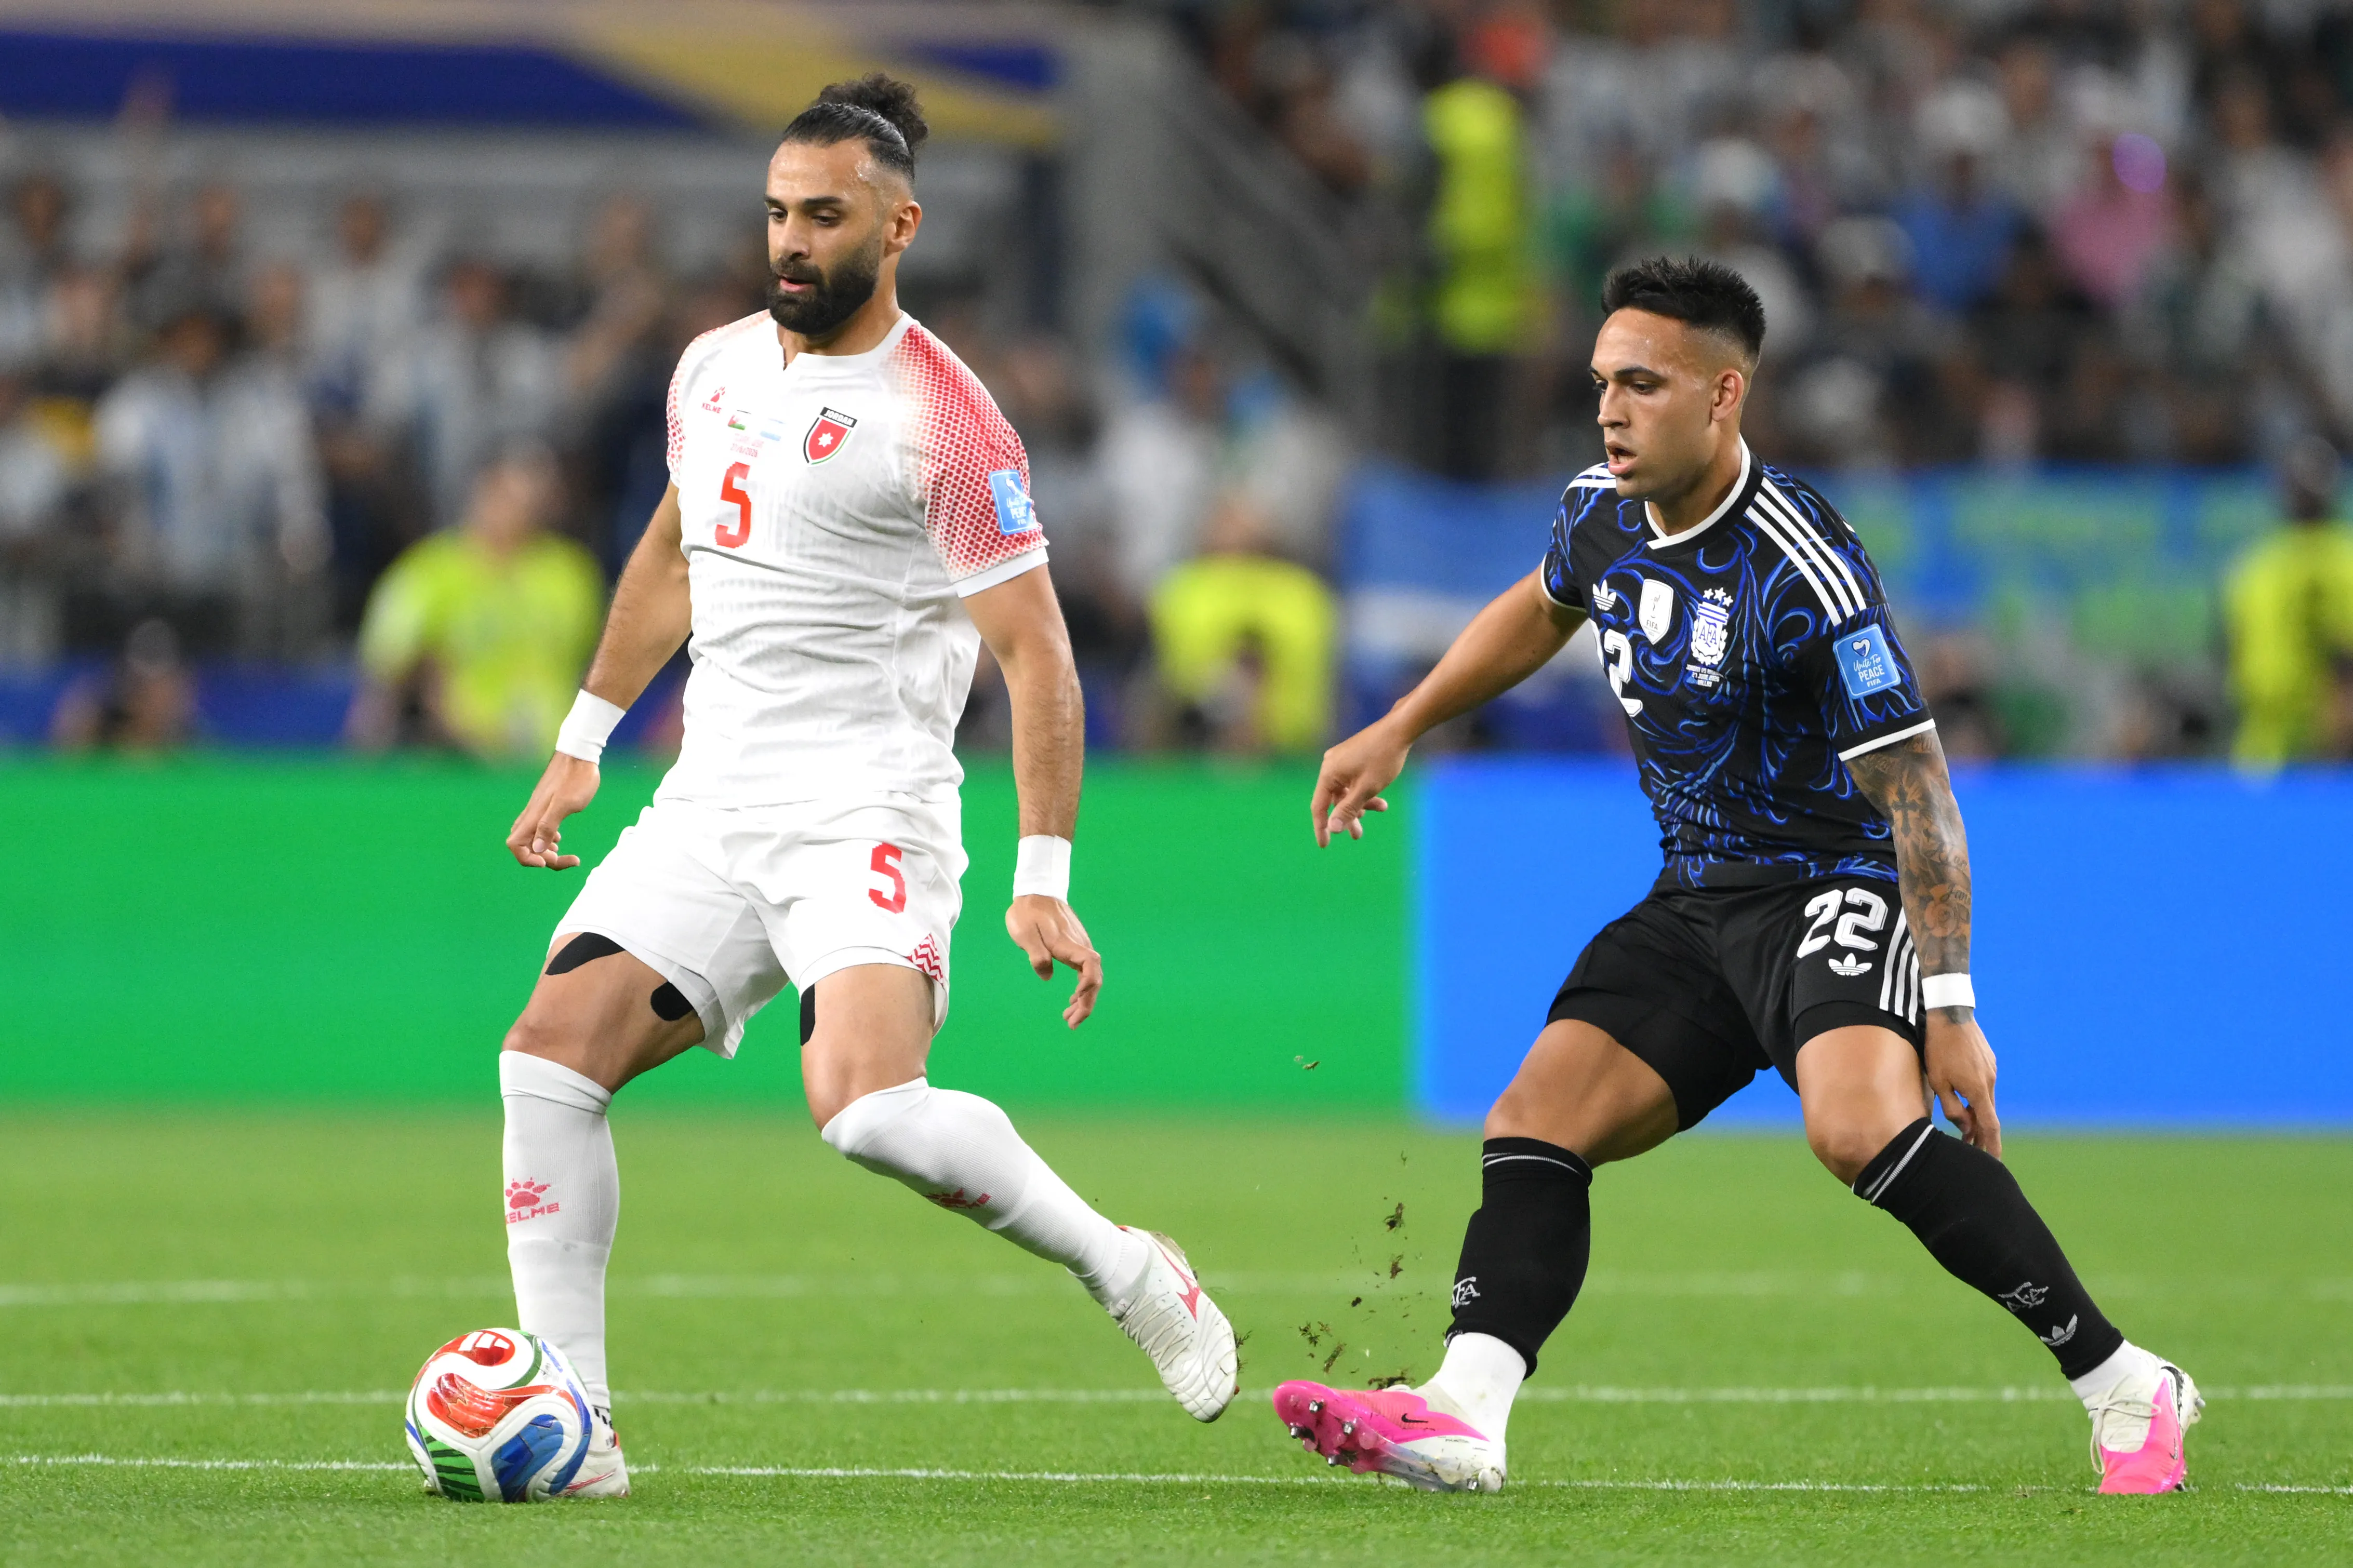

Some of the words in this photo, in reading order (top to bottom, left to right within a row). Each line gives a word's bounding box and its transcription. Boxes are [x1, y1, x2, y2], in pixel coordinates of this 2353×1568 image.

[702, 403, 722, 413] KELME
[824, 409, 854, 426] JORDAN
[714, 461, 751, 549] 5
[1646, 620, 1658, 630] FIFA
[1698, 619, 1717, 647] AFA
[1589, 618, 1643, 717] 2
[1853, 658, 1871, 672] Unite
[1870, 653, 1881, 666] For
[1858, 664, 1885, 682] PEACE
[1867, 678, 1881, 687] FIFA
[868, 842, 906, 914] 5
[1797, 888, 1888, 958] 22
